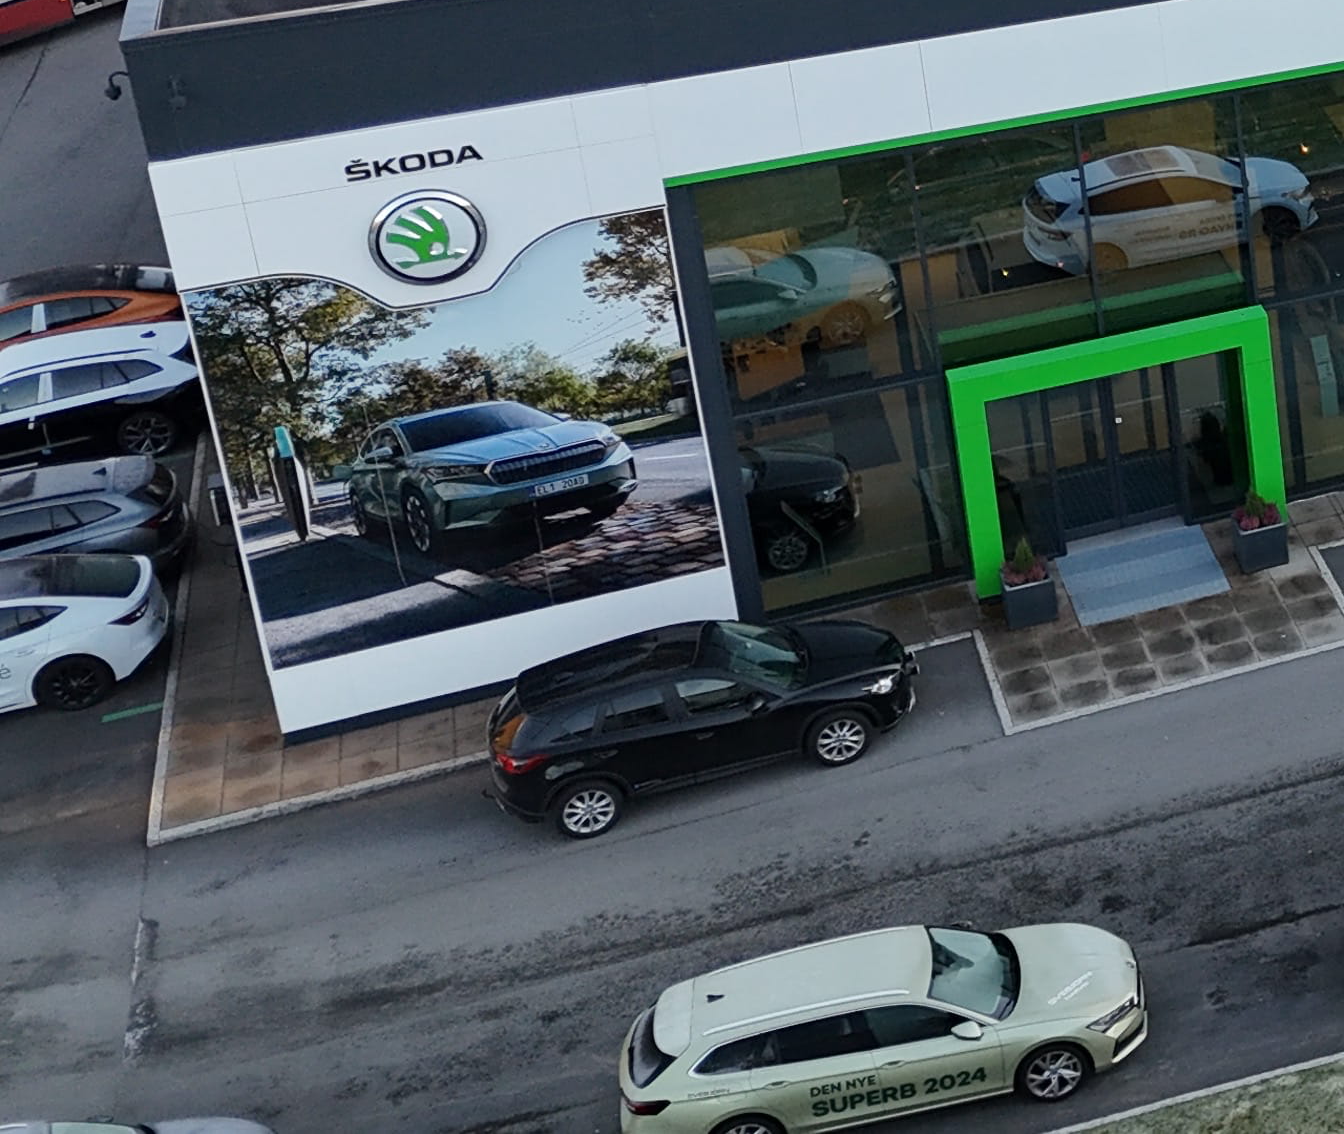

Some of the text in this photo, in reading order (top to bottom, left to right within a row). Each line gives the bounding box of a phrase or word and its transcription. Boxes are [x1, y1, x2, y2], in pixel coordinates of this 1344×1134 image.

[344, 145, 484, 182] ŠKODA
[810, 1074, 877, 1098] DEN NYE
[812, 1067, 987, 1118] SUPERB 2024
